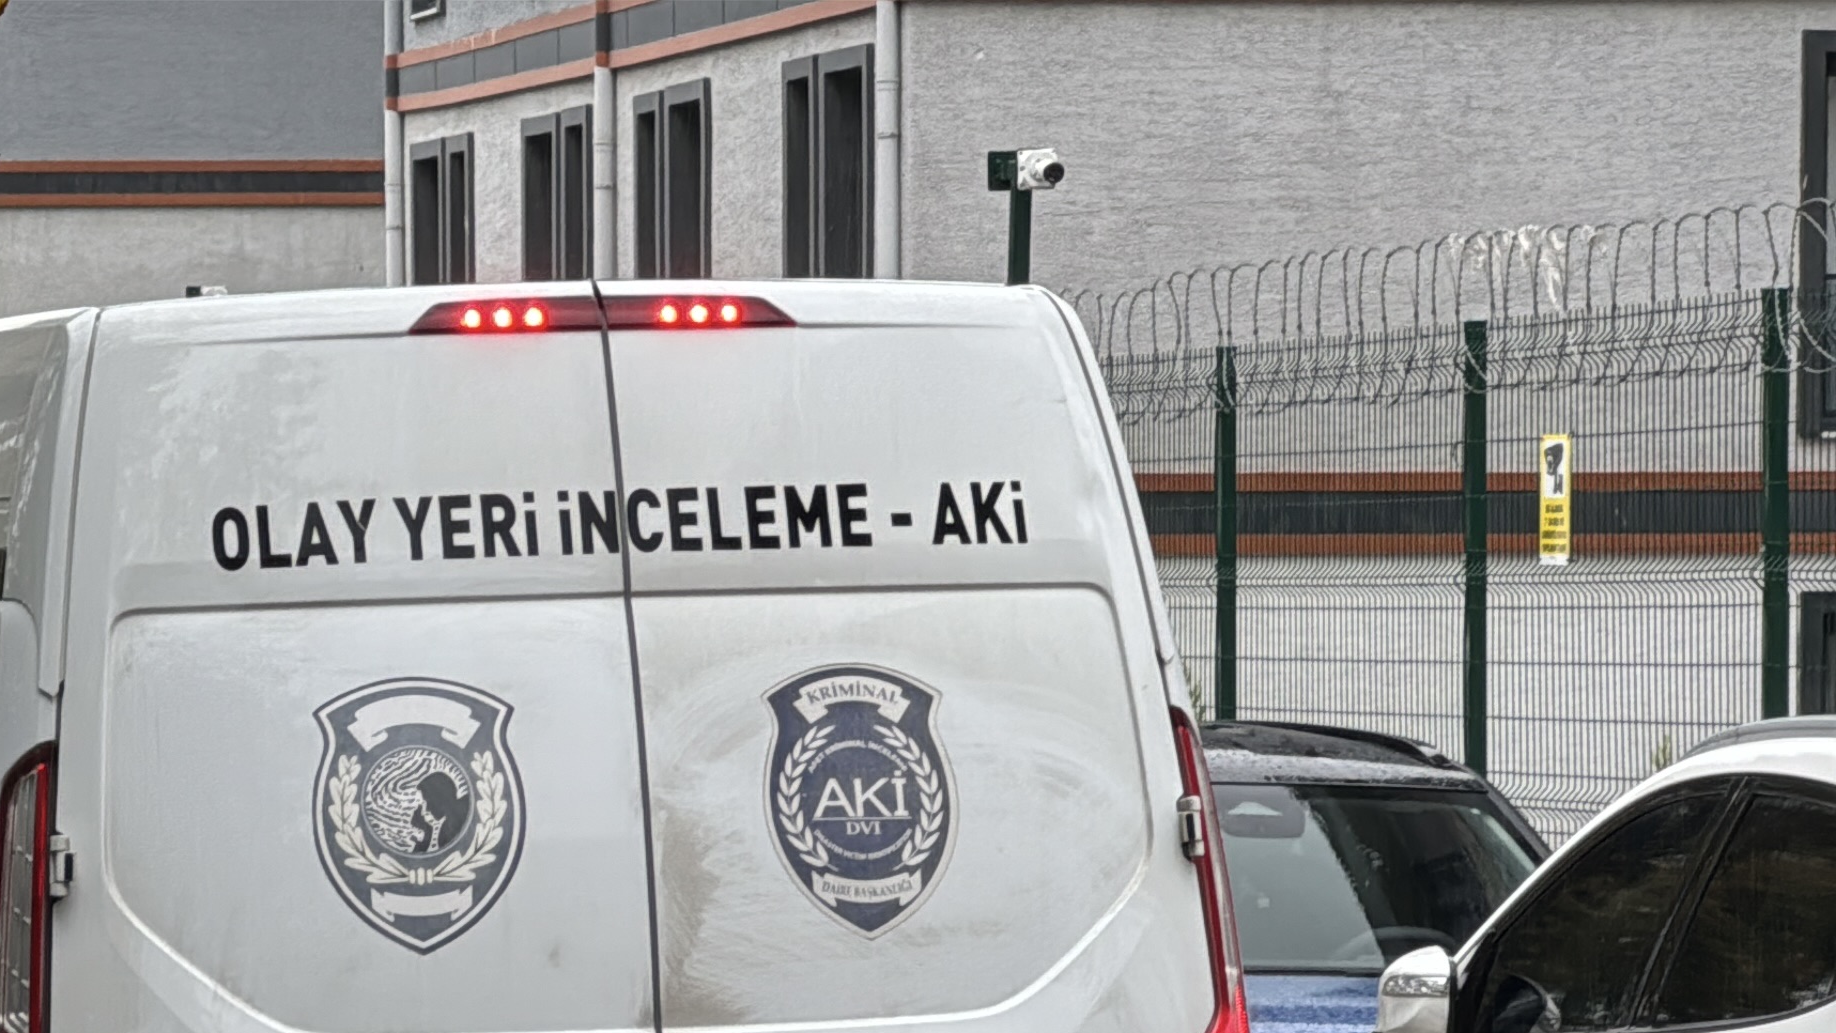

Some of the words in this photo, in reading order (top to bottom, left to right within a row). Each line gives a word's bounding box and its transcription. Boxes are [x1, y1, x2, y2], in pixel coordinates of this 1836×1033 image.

[211, 498, 376, 571] OLAY
[813, 770, 909, 818] AKİ
[846, 820, 882, 835] DVI
